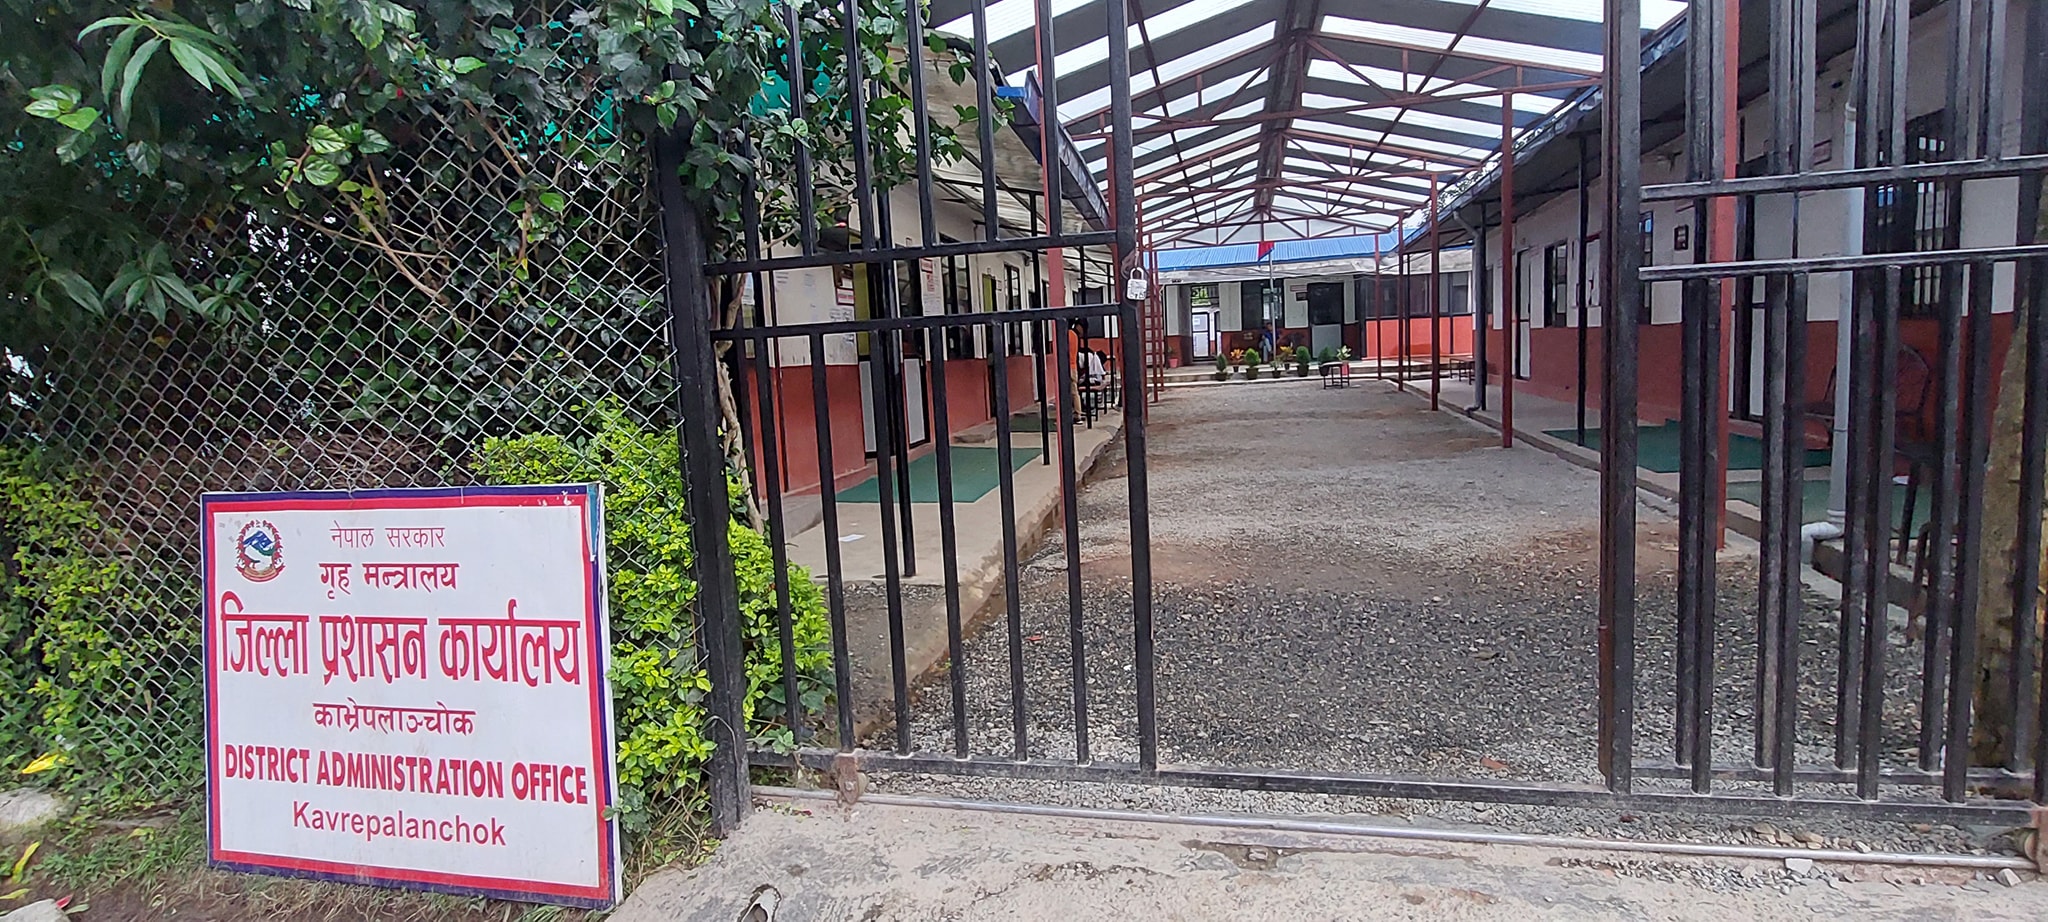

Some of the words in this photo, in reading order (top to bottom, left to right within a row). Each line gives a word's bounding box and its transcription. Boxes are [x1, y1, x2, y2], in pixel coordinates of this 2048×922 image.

[330, 520, 375, 549] नेपाल
[385, 526, 446, 548] सरकार
[319, 562, 352, 600] गृह
[362, 562, 460, 593] मन्त्रालय
[220, 590, 310, 679] जिल्ला
[319, 614, 428, 686] प्रशासन
[437, 598, 582, 688] कार्यालय
[312, 696, 477, 736] काभ्रेपलाञ्चोक
[224, 743, 311, 784] DISTRICT
[316, 750, 502, 800] ADMINISTRATION
[510, 761, 589, 805] OFFICE
[293, 801, 507, 847] Kavrepalanchok
